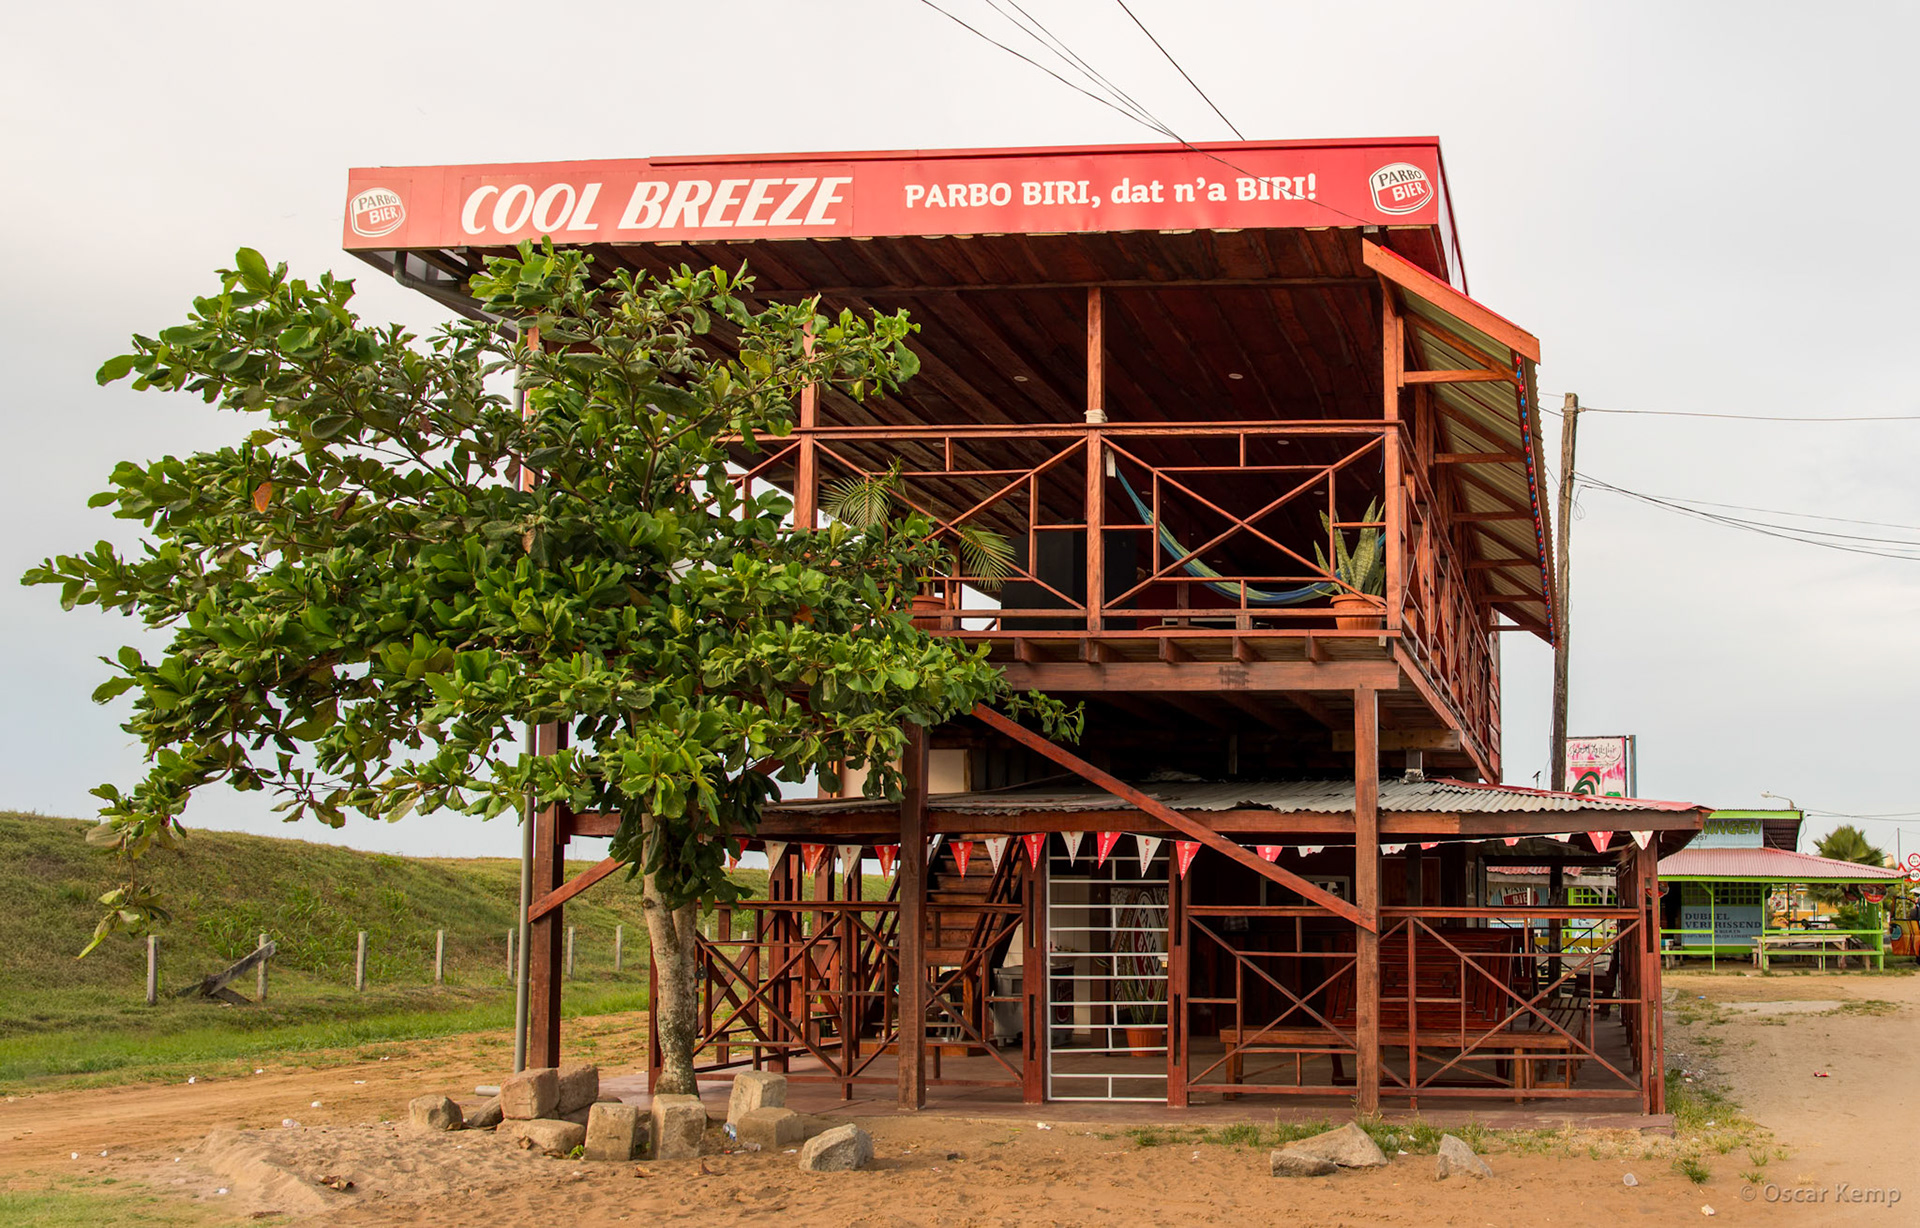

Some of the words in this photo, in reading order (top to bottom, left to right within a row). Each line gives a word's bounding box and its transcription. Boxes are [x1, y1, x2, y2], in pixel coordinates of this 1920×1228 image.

[1378, 169, 1422, 187] PARBO
[904, 182, 1012, 208] PARBO
[1021, 180, 1101, 208] BIRI,
[1111, 177, 1164, 204] dat
[1235, 173, 1317, 201] BIRI!
[1392, 181, 1426, 202] BIER
[358, 194, 397, 211] PARBO
[461, 182, 602, 235] COOL
[617, 176, 853, 230] BREEZE
[369, 206, 398, 225] BIER
[1512, 893, 1527, 905] BIE
